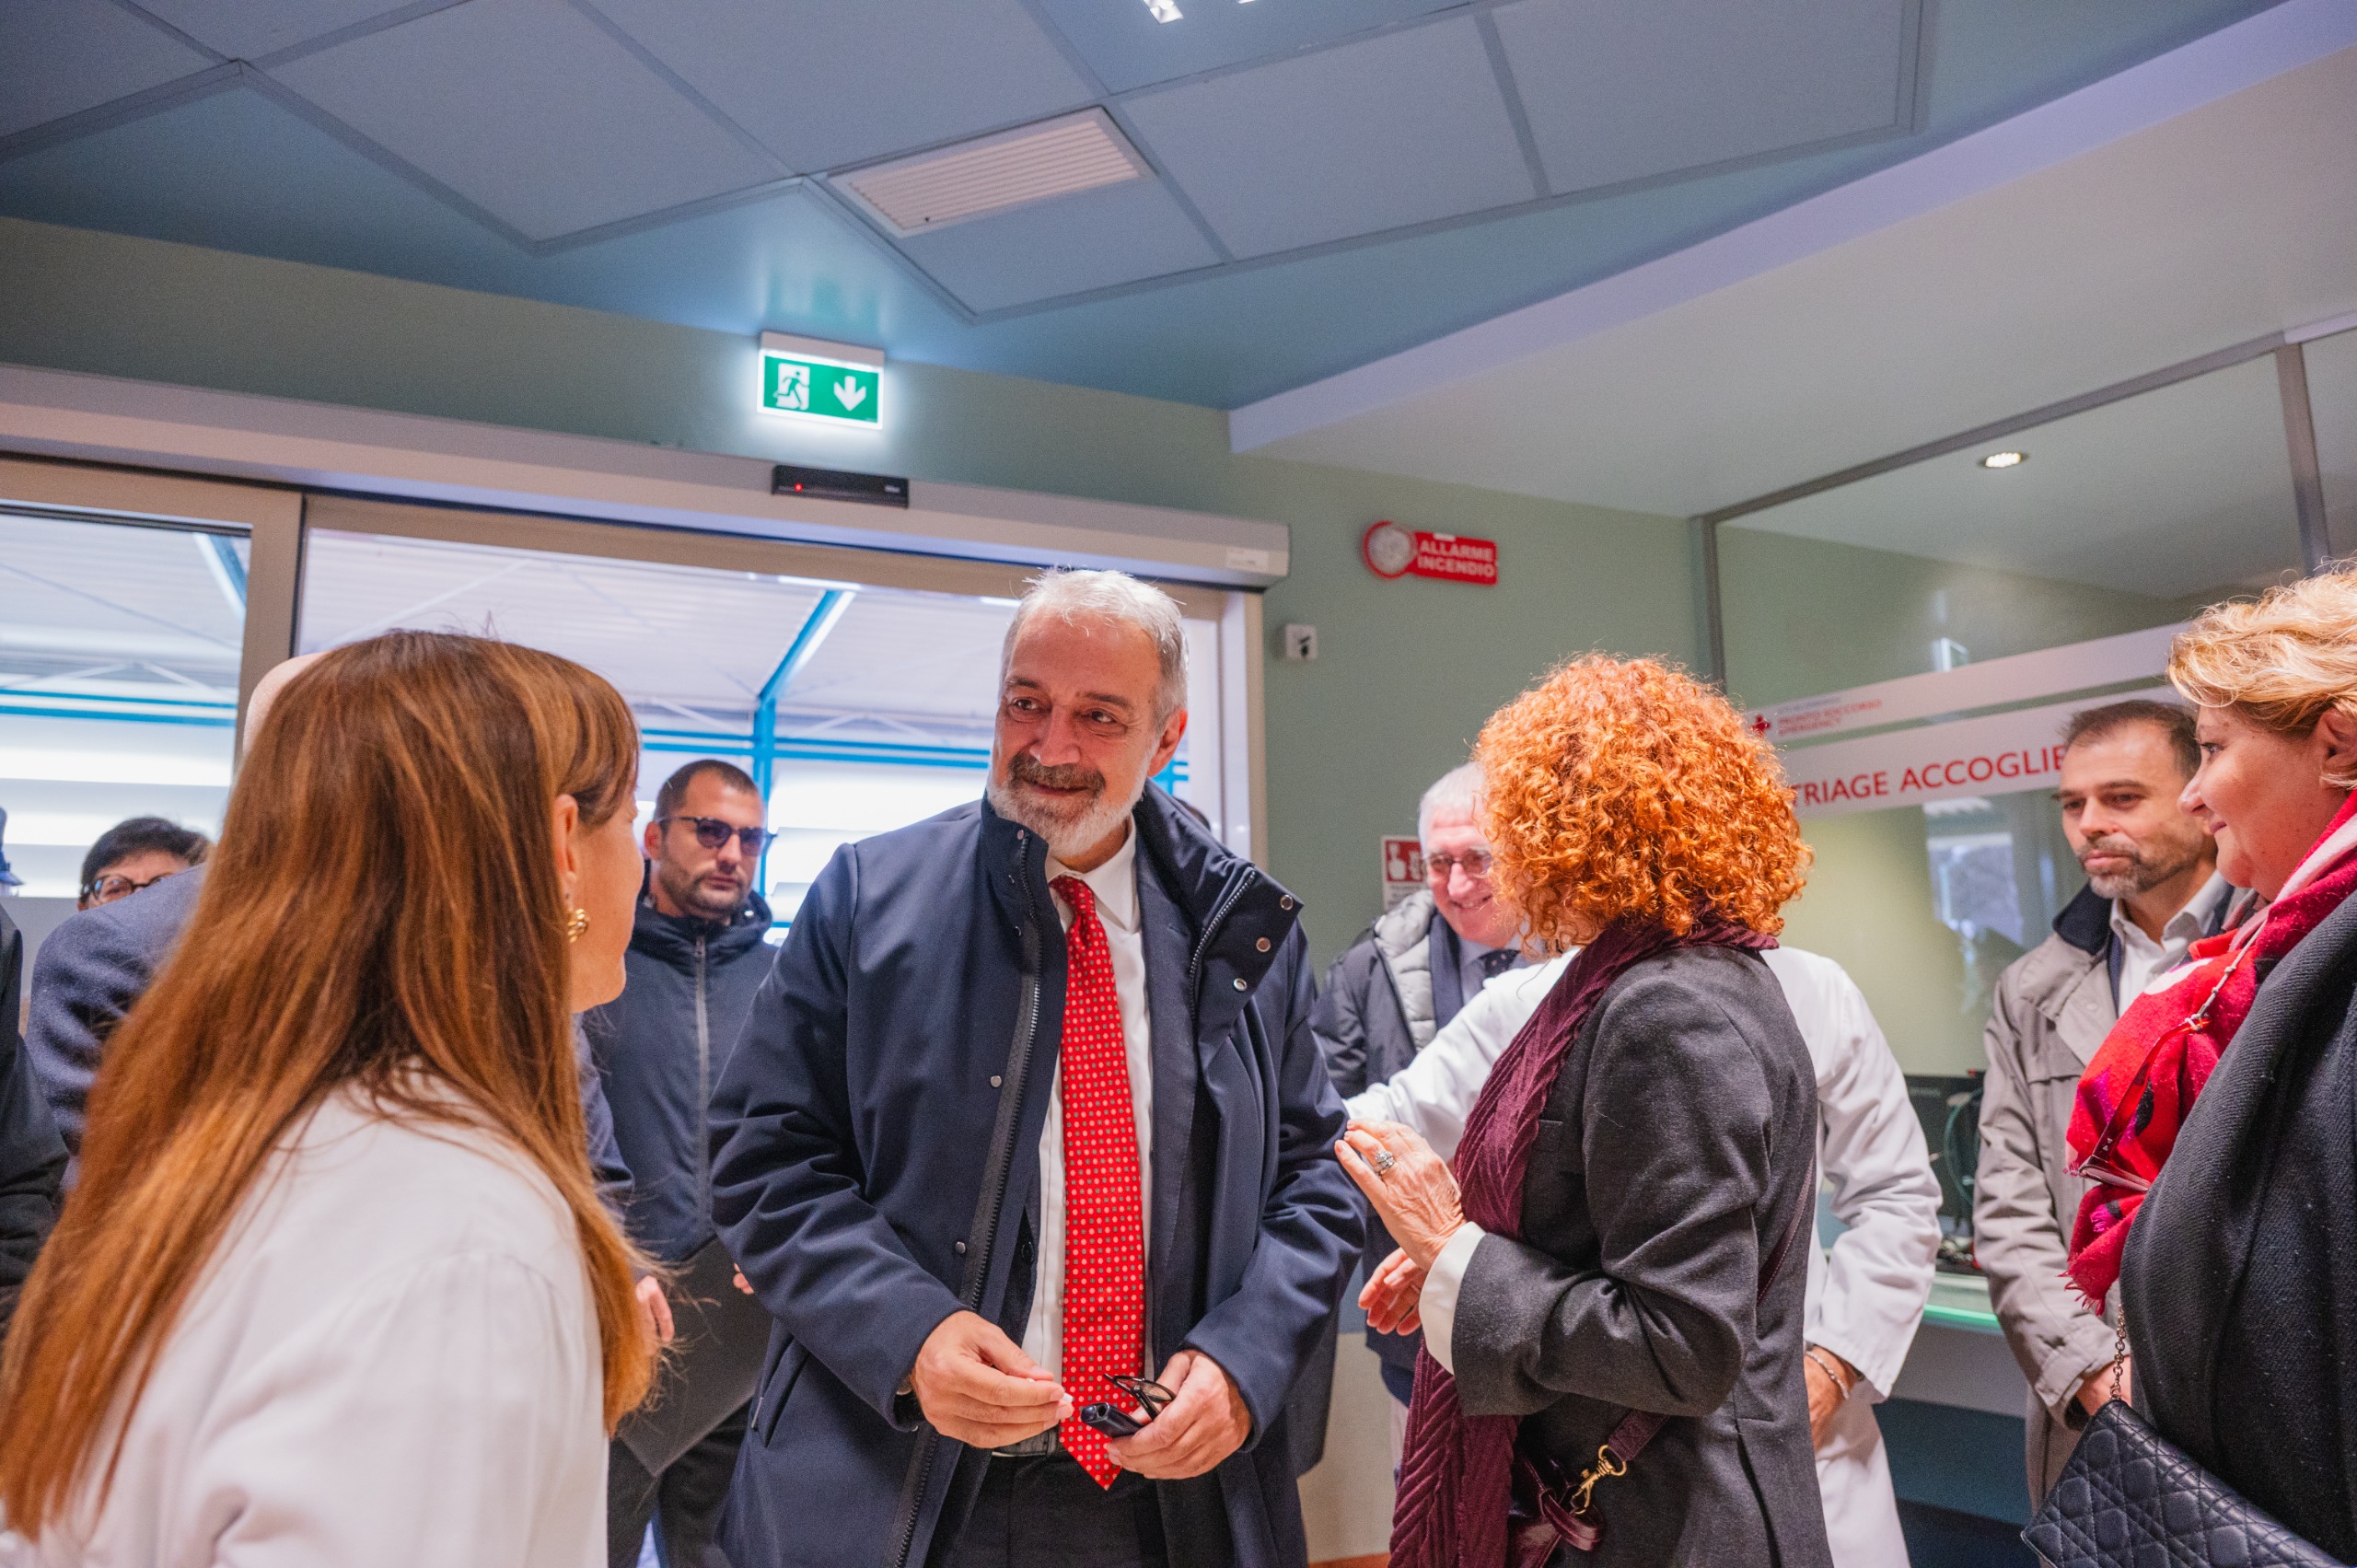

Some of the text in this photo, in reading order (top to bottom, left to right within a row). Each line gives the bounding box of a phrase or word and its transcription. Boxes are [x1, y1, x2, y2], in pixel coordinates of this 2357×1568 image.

[1420, 540, 1493, 561] ALLARME
[1418, 556, 1495, 577] INCENDIO
[1792, 772, 1889, 807] TRIAGE
